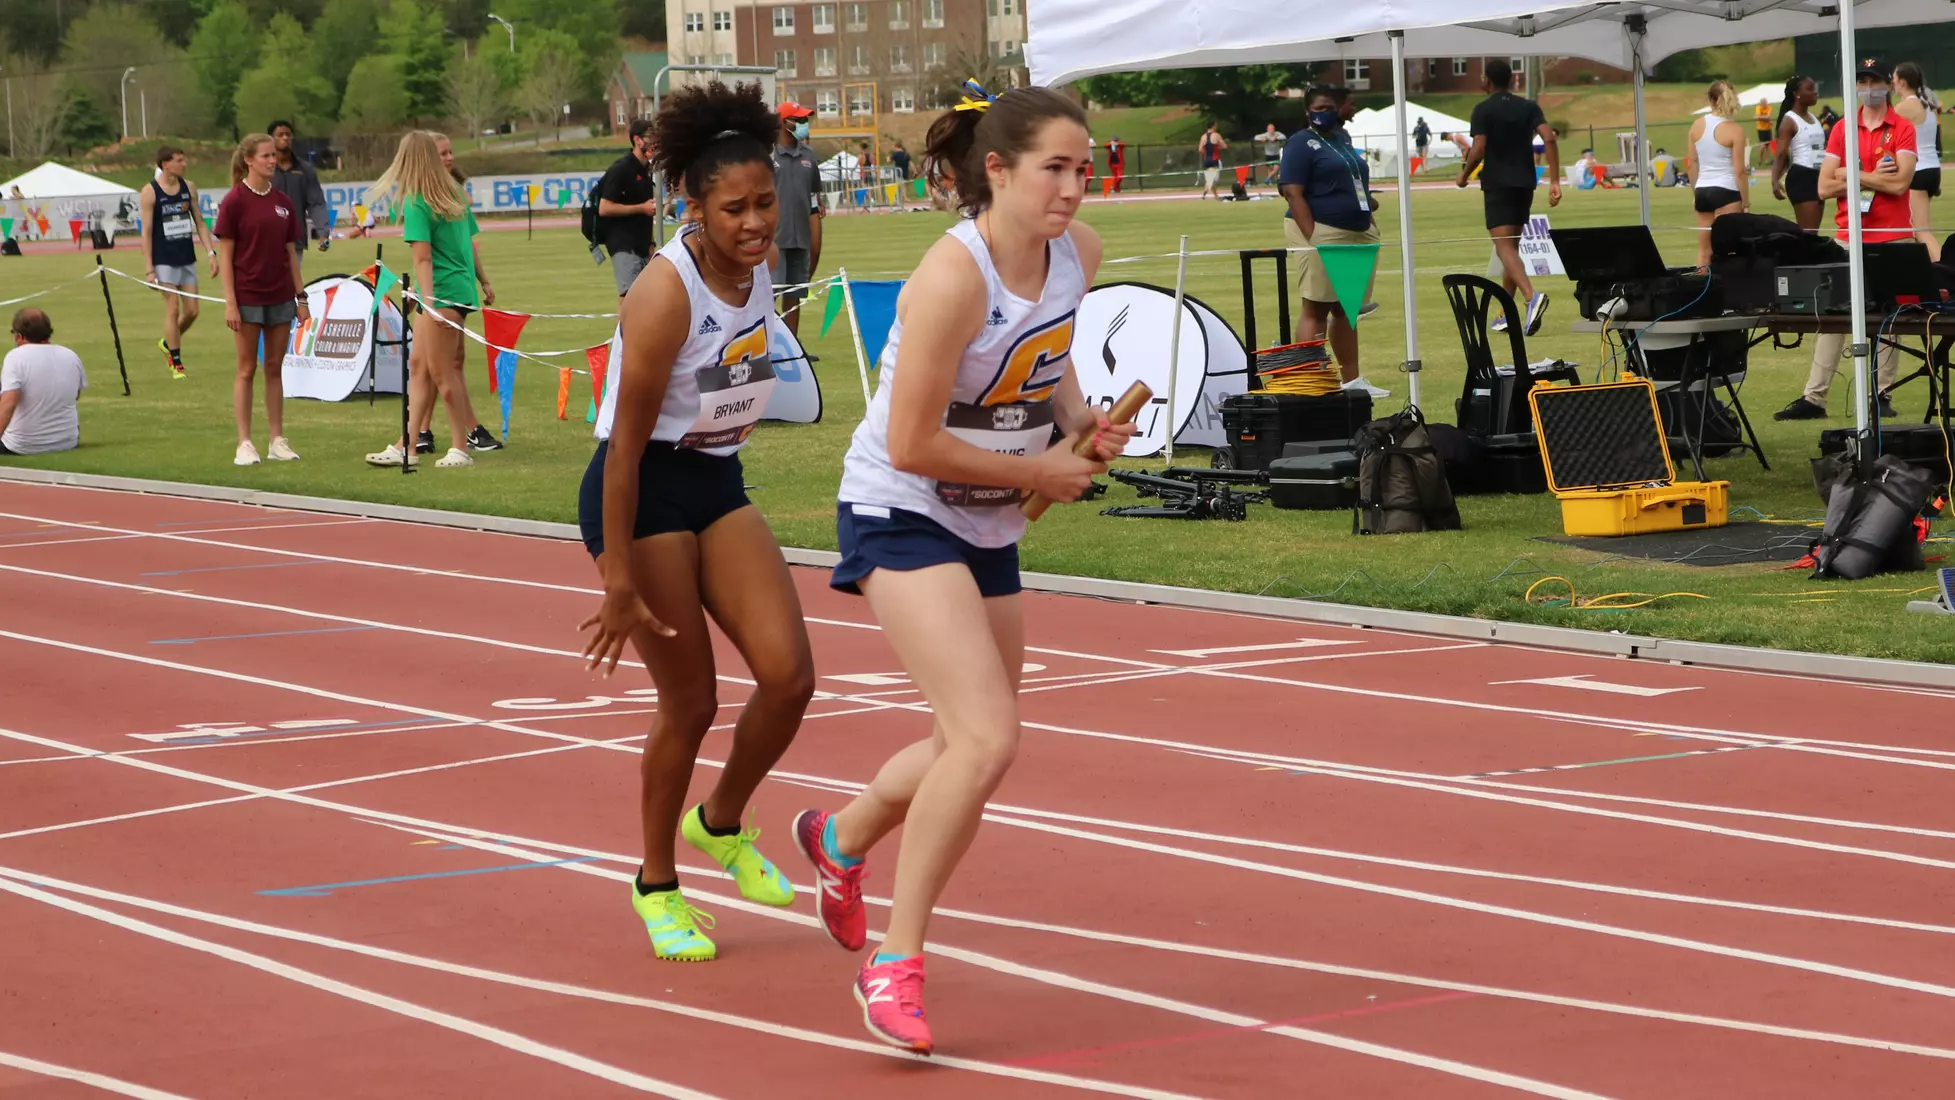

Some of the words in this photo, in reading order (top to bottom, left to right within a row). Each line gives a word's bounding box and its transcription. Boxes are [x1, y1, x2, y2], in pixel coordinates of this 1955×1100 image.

[322, 323, 362, 337] ASHEVILLE
[698, 324, 722, 335] adidas
[713, 398, 755, 420] BRYANT
[970, 488, 1014, 499] #SOCONTF
